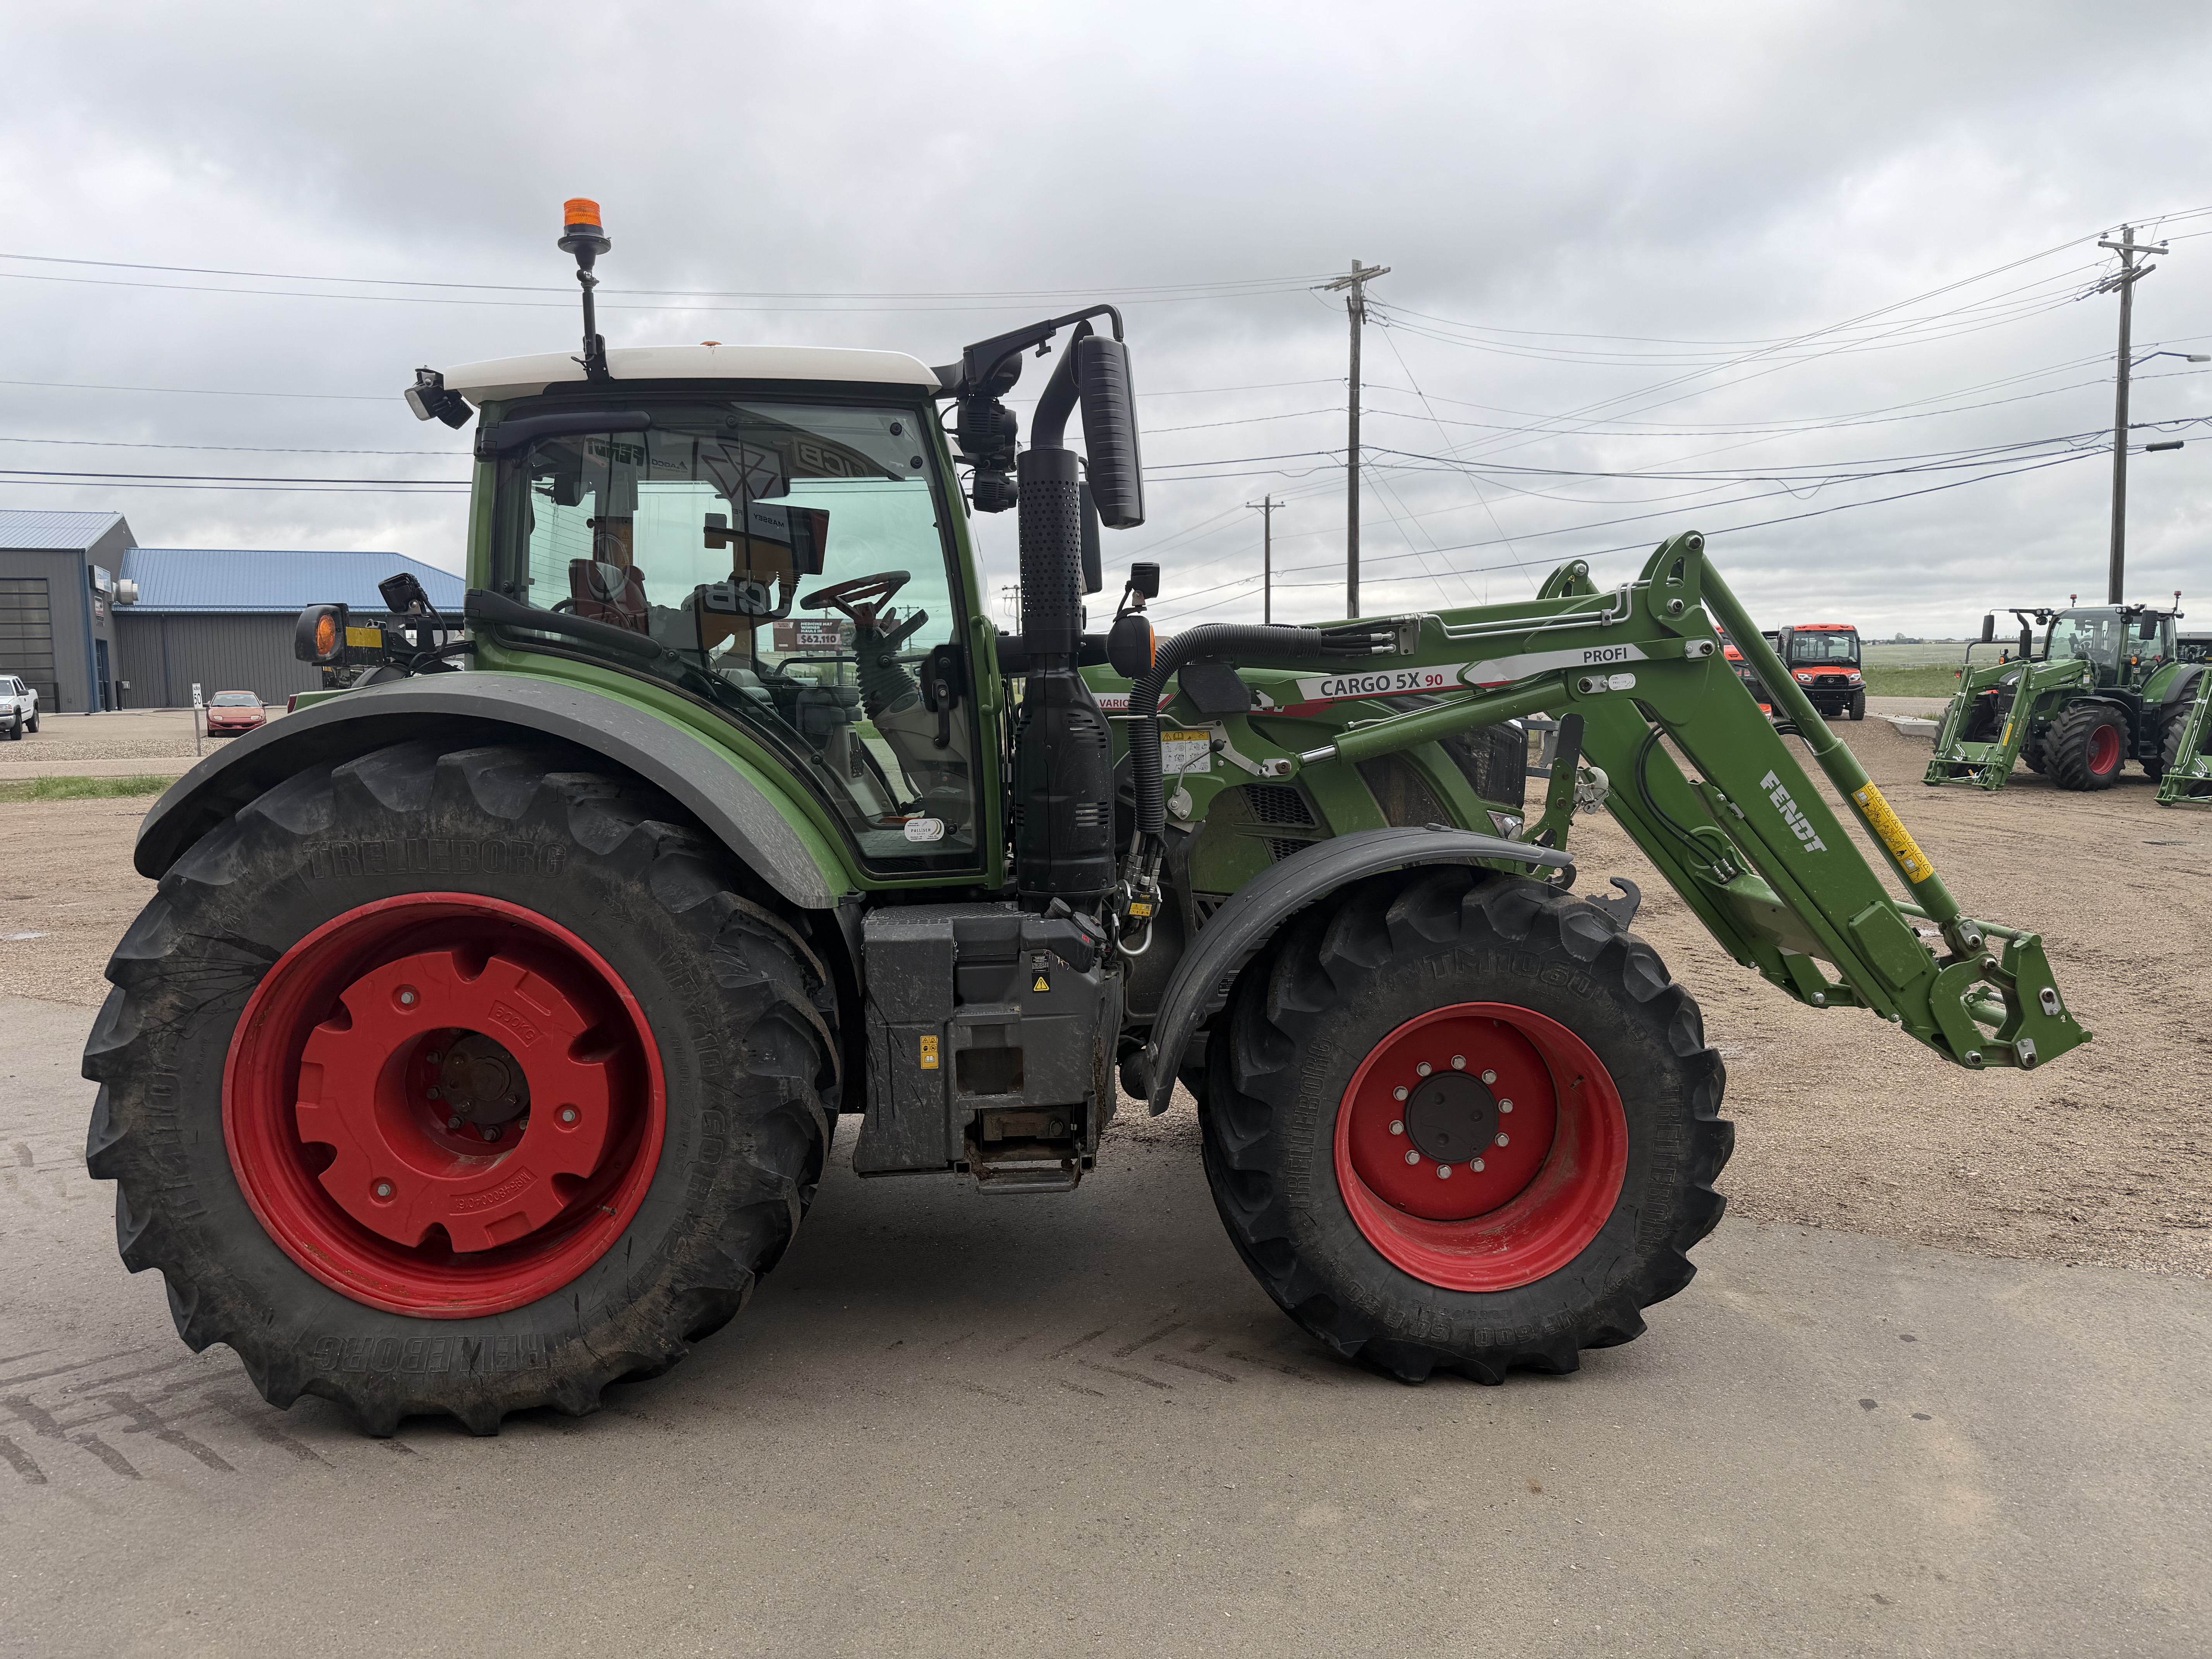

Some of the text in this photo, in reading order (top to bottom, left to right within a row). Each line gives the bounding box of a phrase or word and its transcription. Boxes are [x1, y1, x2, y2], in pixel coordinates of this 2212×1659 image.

[801, 635, 836, 644] $62,110
[1583, 647, 1628, 663] PROFI
[194, 694, 201, 704] 50
[1321, 672, 1443, 696] CARGO 5X 90
[1760, 770, 1827, 852] FENDT
[303, 838, 566, 879] TRELLEBORG
[1422, 945, 1598, 1002] TM1060
[496, 1007, 536, 1039] 600KG
[1284, 1036, 1333, 1212] TRELLEBORG
[1634, 1082, 1684, 1258] TRELLEBORG
